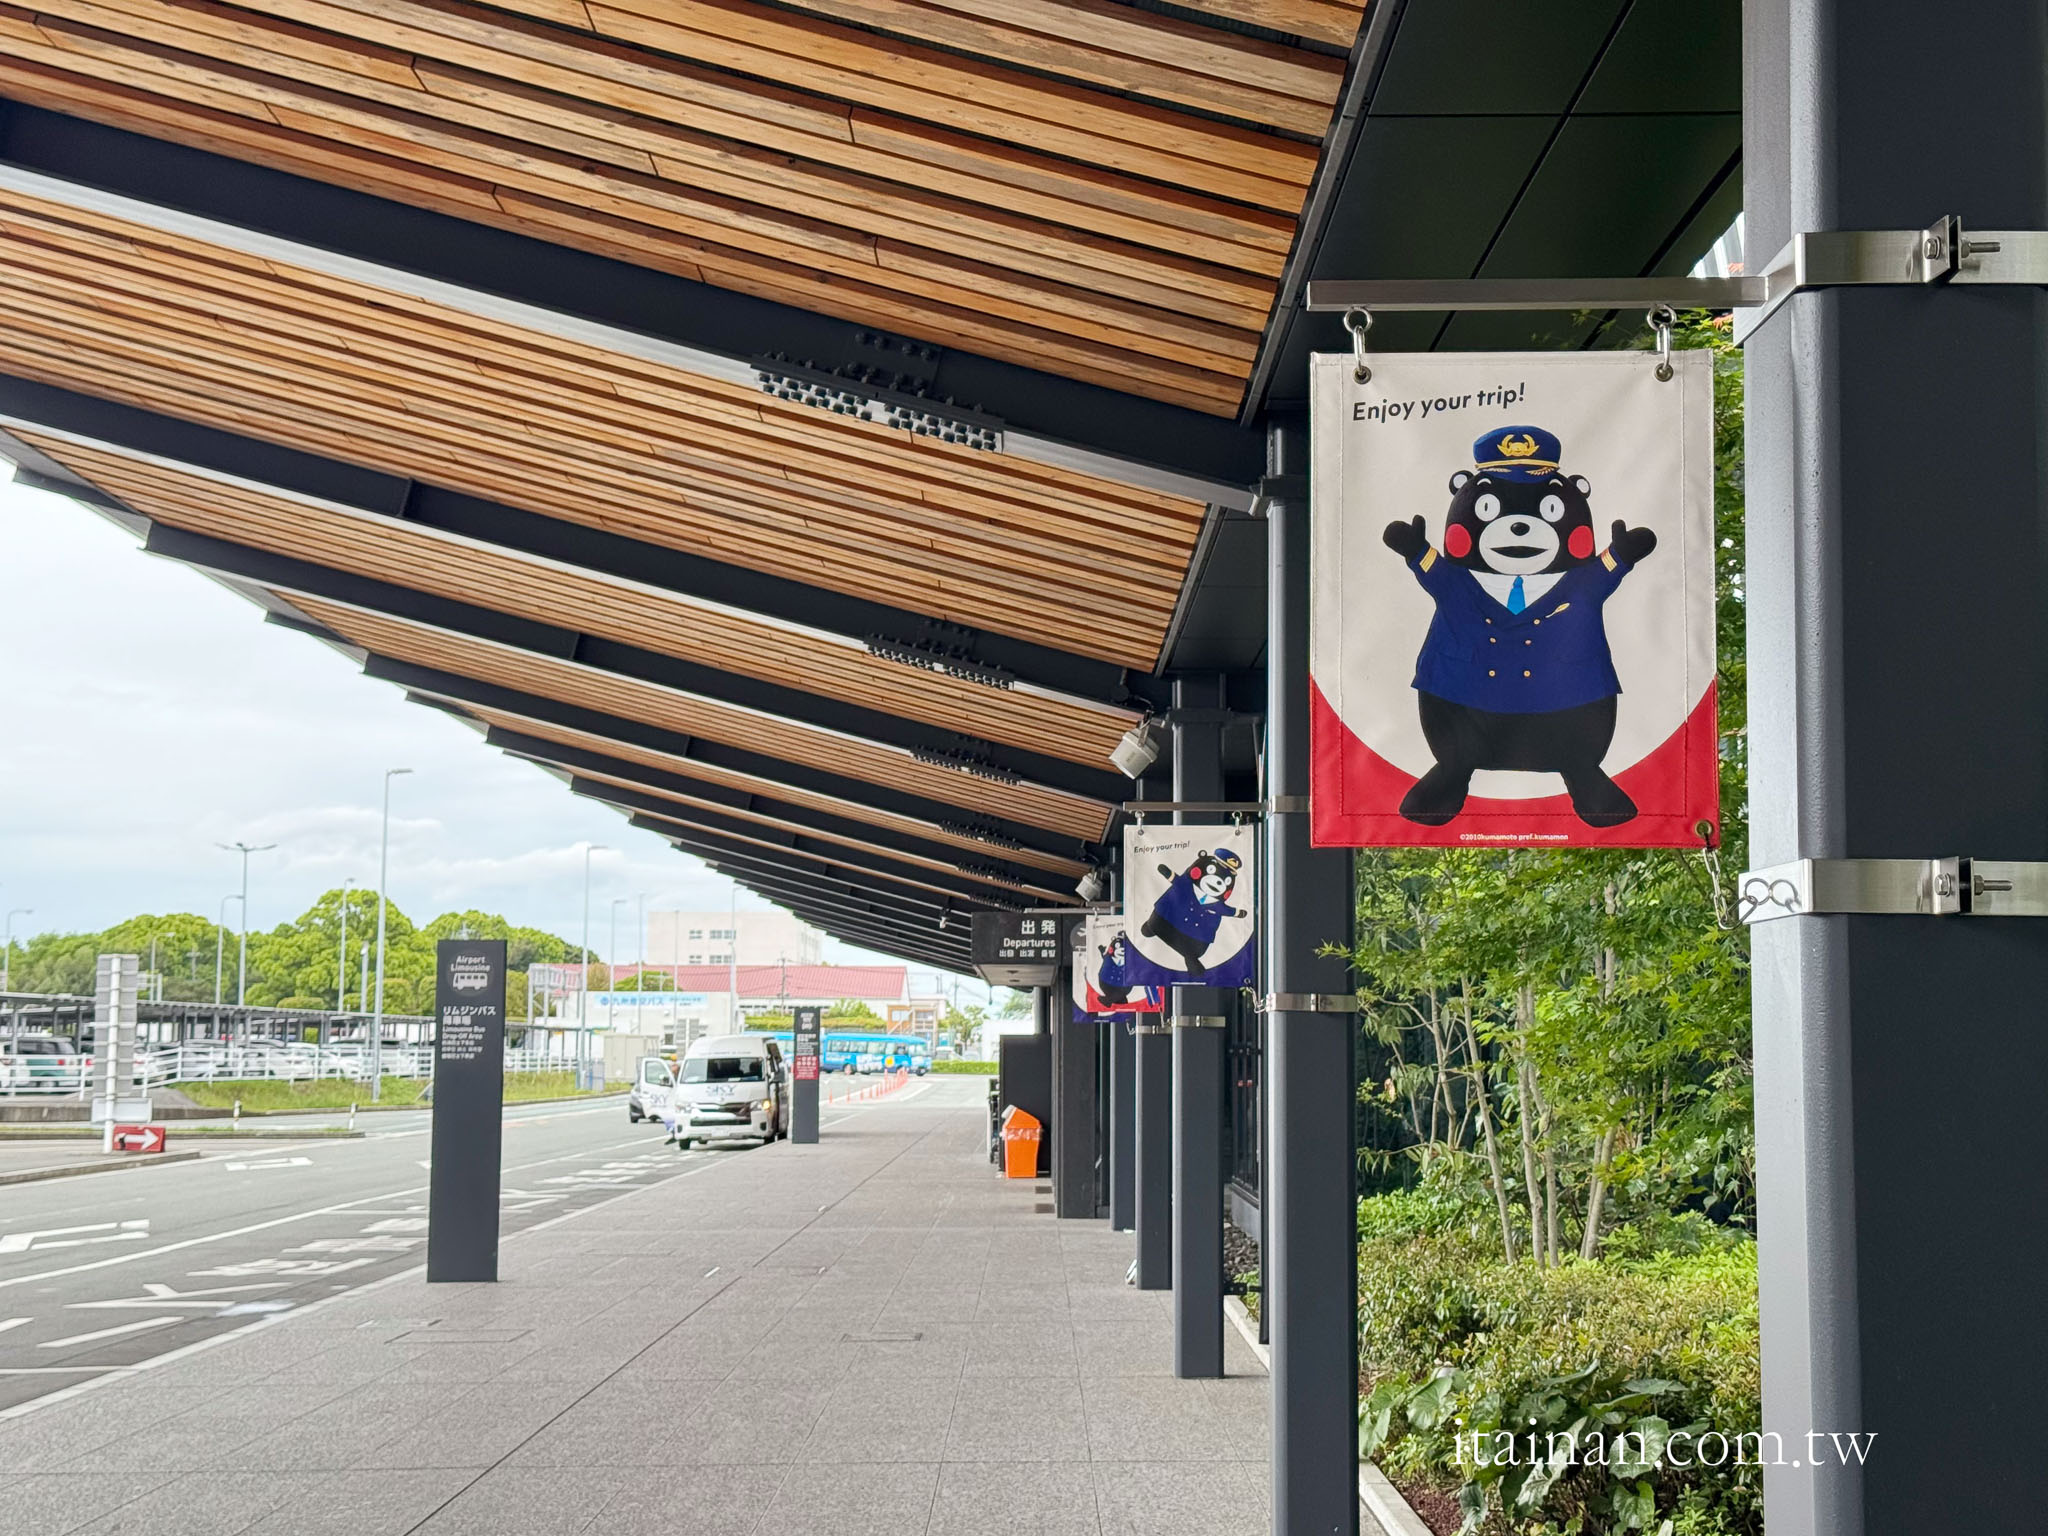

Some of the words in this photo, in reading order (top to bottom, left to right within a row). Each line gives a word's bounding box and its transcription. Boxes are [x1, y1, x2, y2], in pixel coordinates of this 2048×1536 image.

[1352, 398, 1415, 424] Enjoy
[1421, 394, 1472, 419] your
[1477, 381, 1526, 409] trip!
[1133, 845, 1155, 854] Enjoy
[1156, 844, 1173, 852] your
[1174, 840, 1191, 851] trip!
[1021, 919, 1056, 935] 出発
[1003, 937, 1056, 950] Departures
[456, 955, 486, 965] Airport
[450, 963, 491, 972] Limousine
[443, 1006, 497, 1016] リムジンバス
